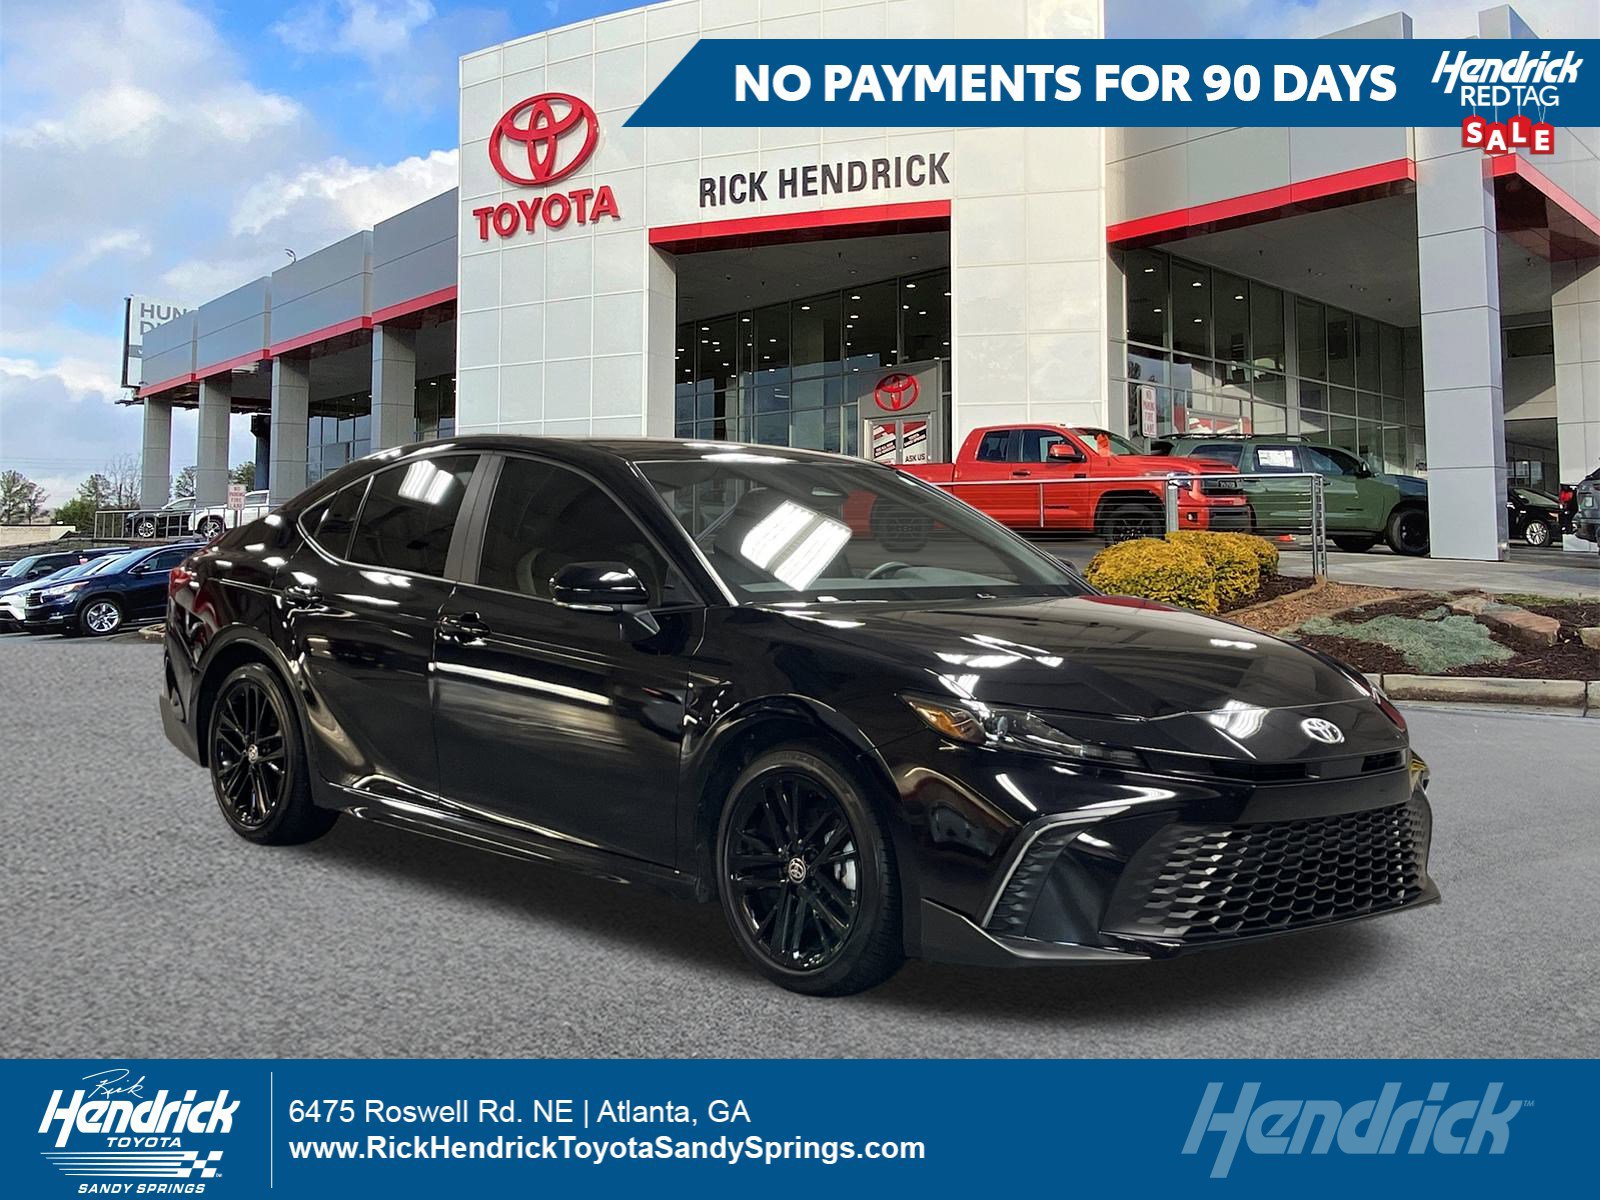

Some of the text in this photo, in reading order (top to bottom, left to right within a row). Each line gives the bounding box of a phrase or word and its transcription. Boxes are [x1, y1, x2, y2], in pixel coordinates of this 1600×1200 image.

[699, 152, 951, 208] RICK HENDRICK
[472, 185, 620, 241] TOYOTA
[905, 453, 926, 463] ASK US
